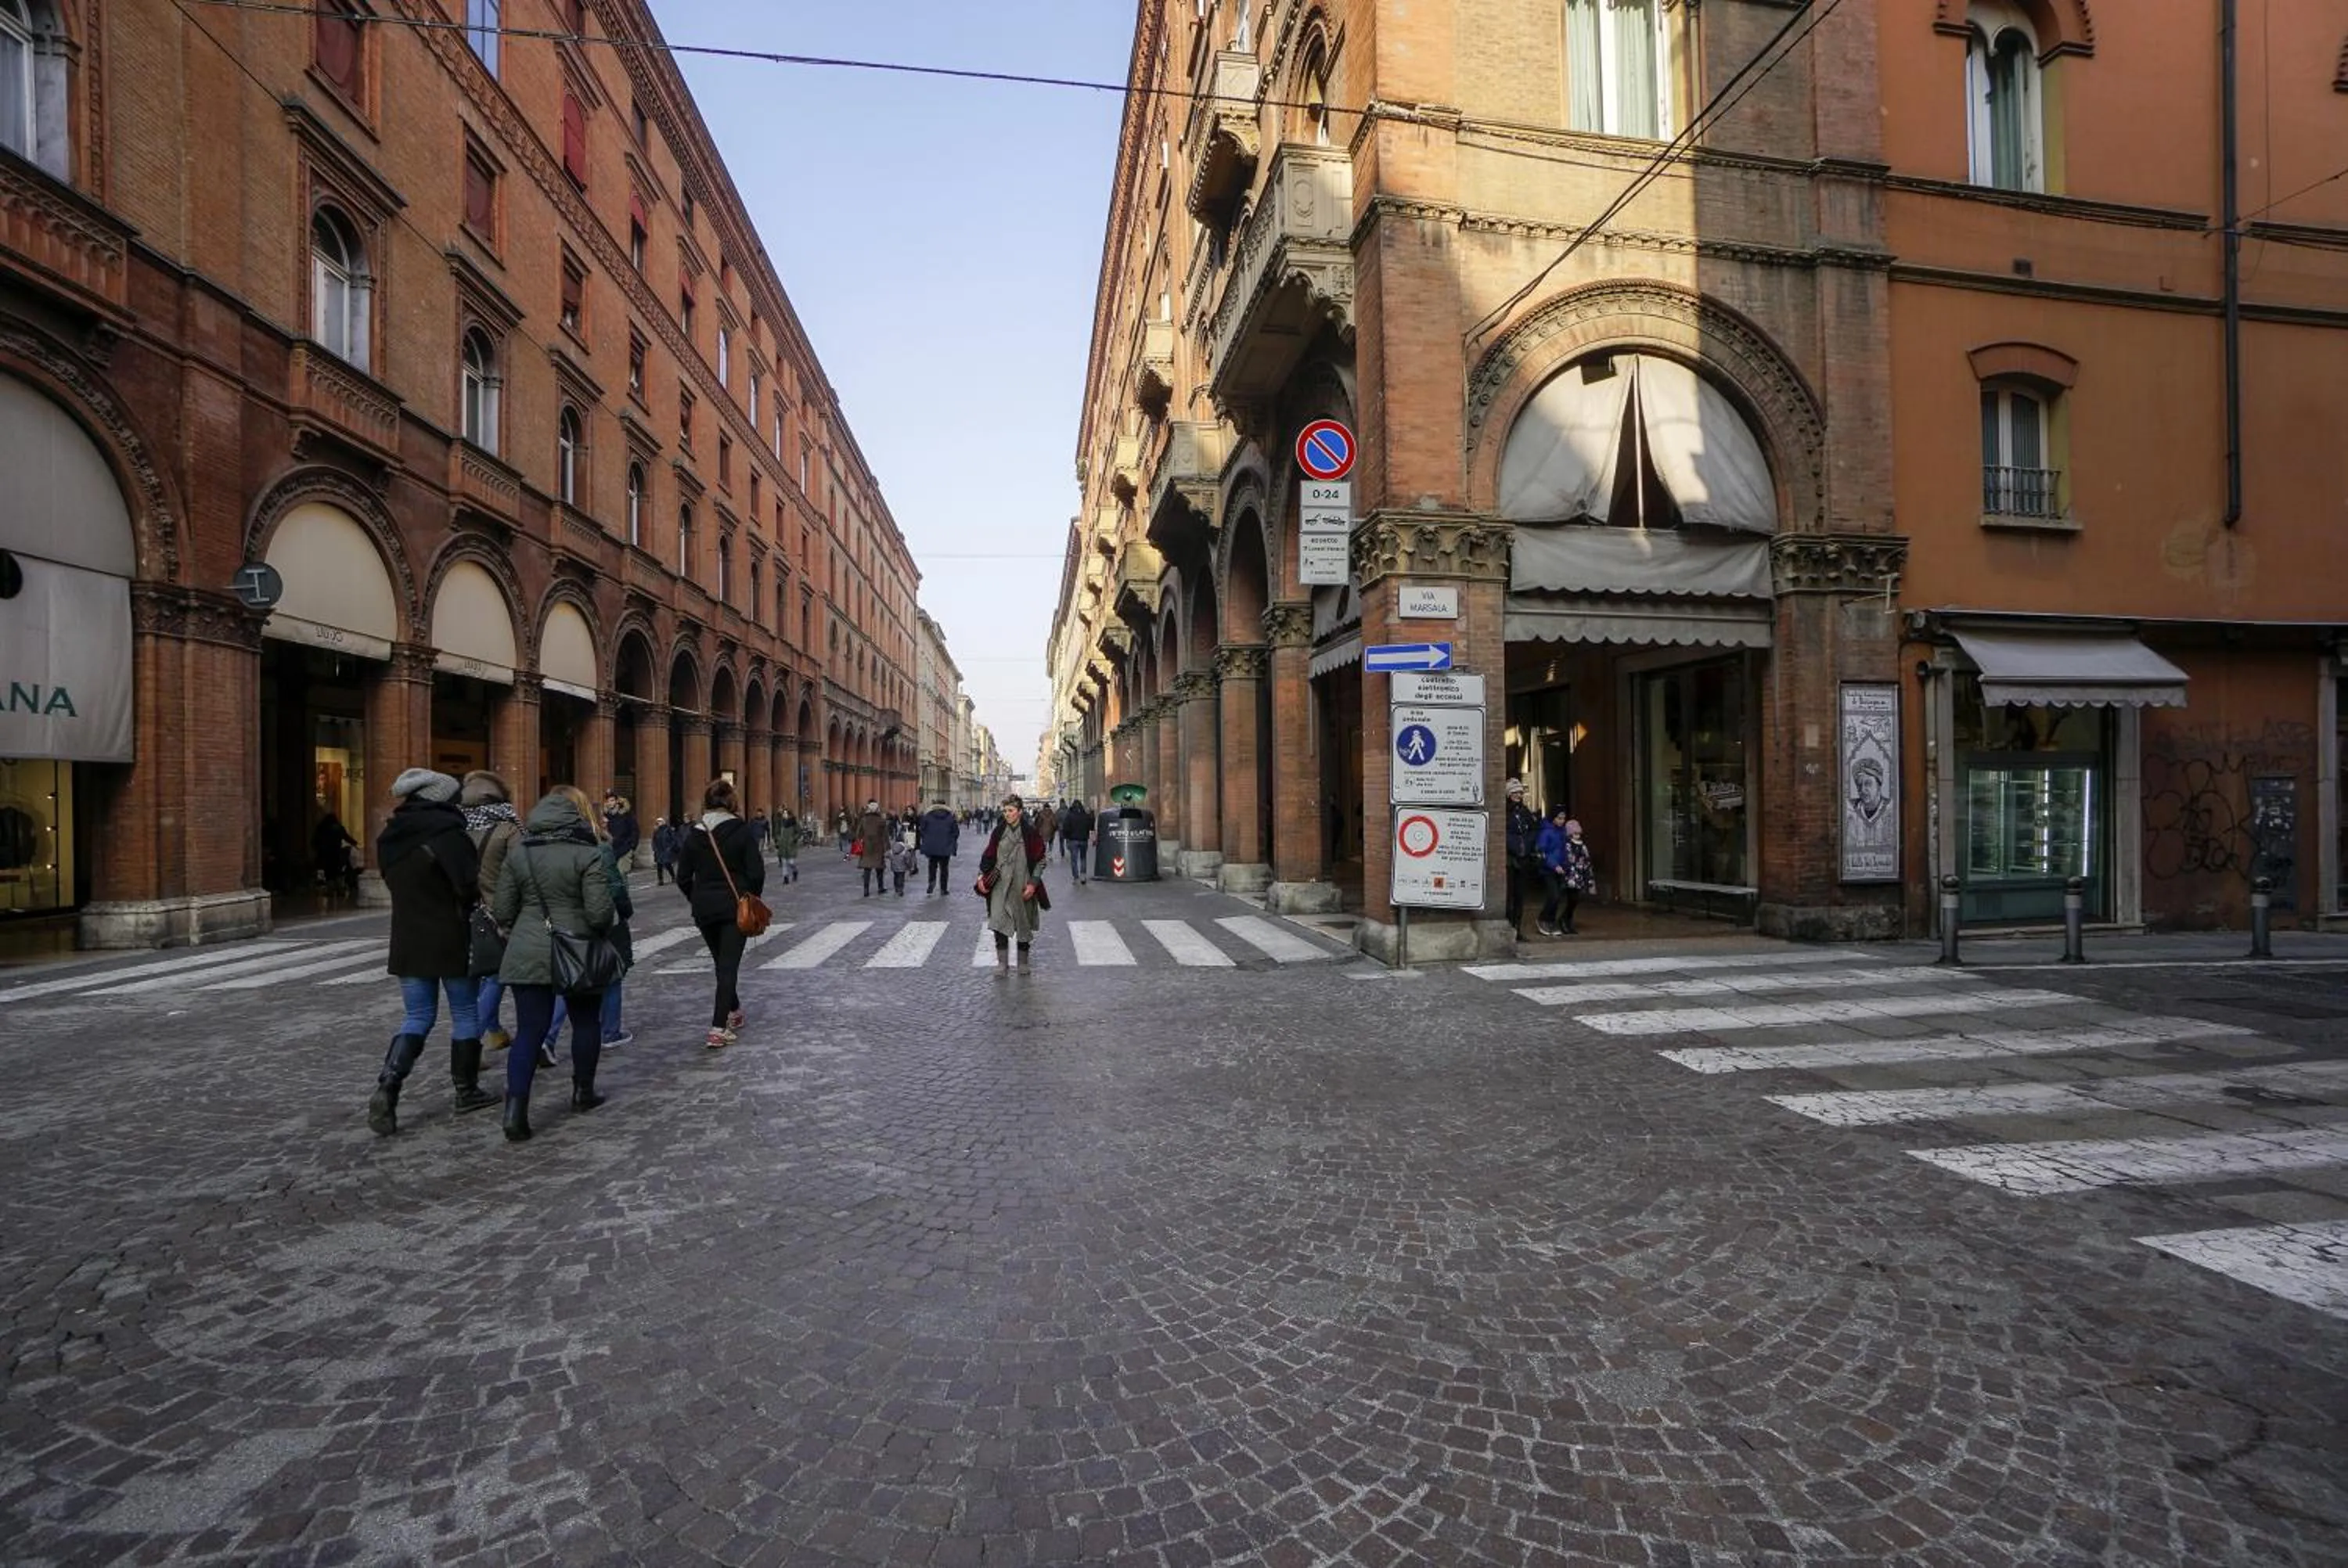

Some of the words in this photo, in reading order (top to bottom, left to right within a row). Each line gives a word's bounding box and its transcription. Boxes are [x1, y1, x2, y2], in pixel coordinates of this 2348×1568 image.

[1421, 592, 1435, 600] VIA
[1410, 603, 1448, 613] MARSALA
[0, 682, 78, 718] NA
